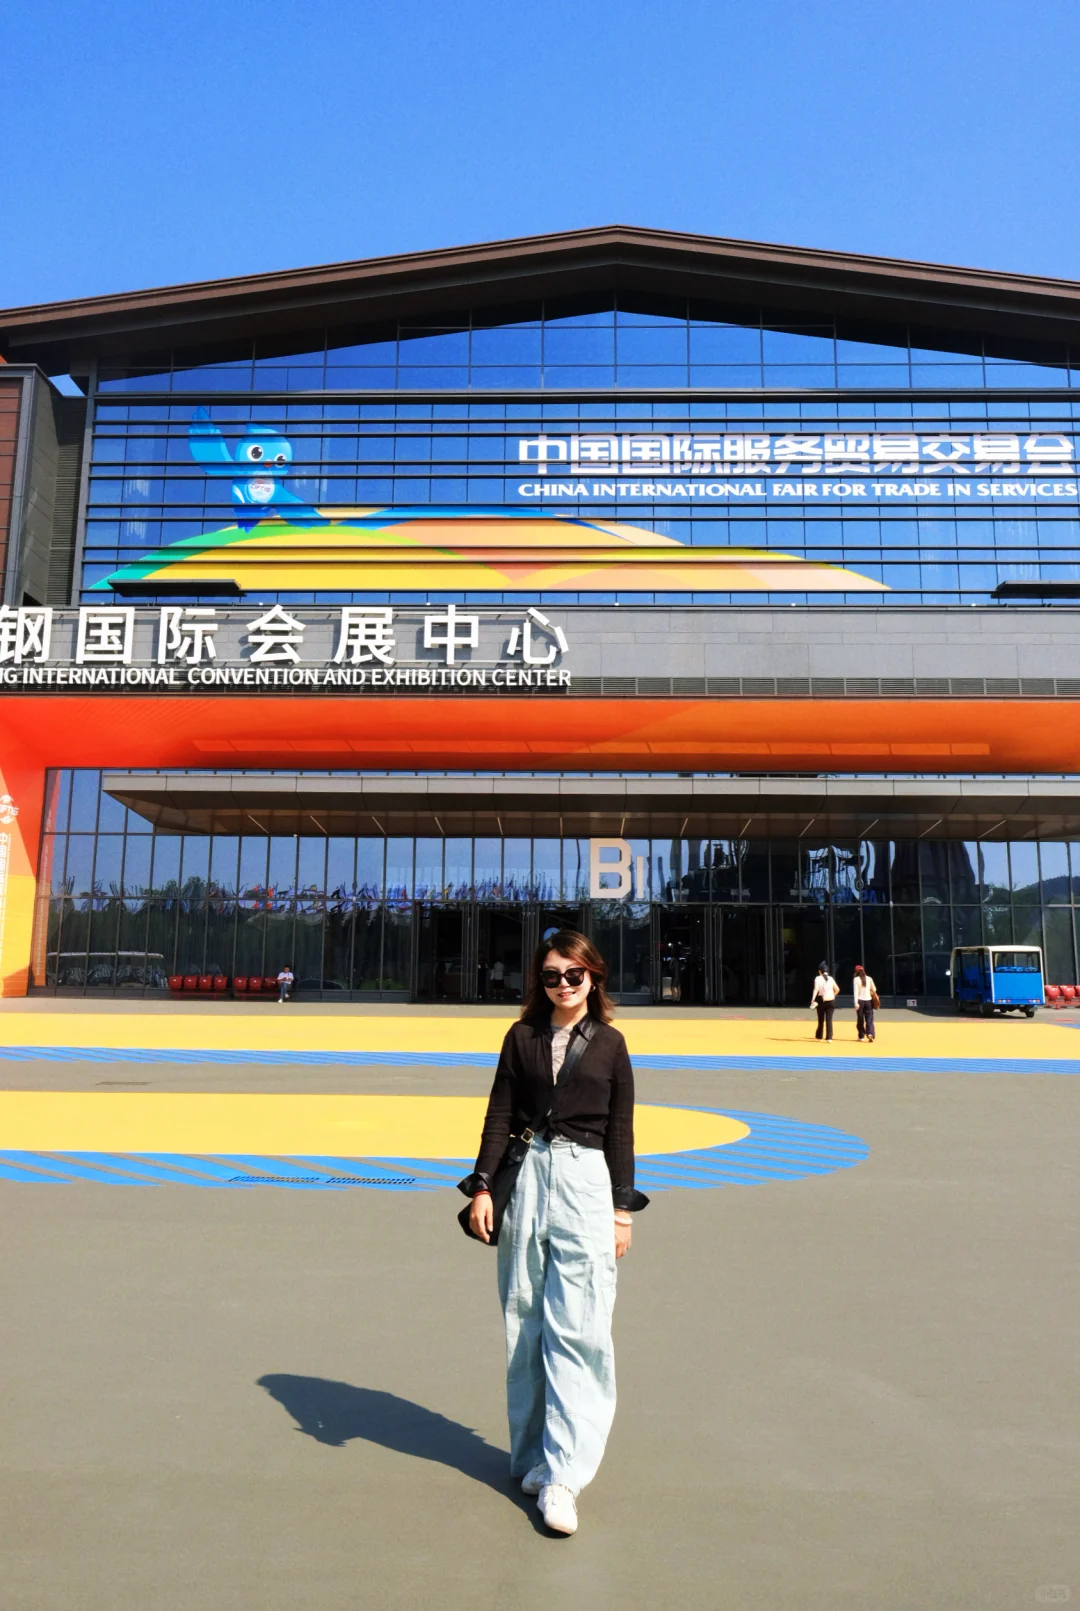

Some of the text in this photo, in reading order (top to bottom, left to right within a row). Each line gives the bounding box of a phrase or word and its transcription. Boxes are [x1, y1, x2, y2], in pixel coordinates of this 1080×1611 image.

[518, 434, 1076, 474] 中国国际服务贸易交易会
[518, 483, 1079, 497] CHINA INTERNATIONAL FAIR FOR TRADE IN SERVICES
[0, 604, 569, 665] 钢国际会展中心
[0, 667, 572, 687] G INTERNATIONAL CONVENTION AND EXHIBITION CENTER
